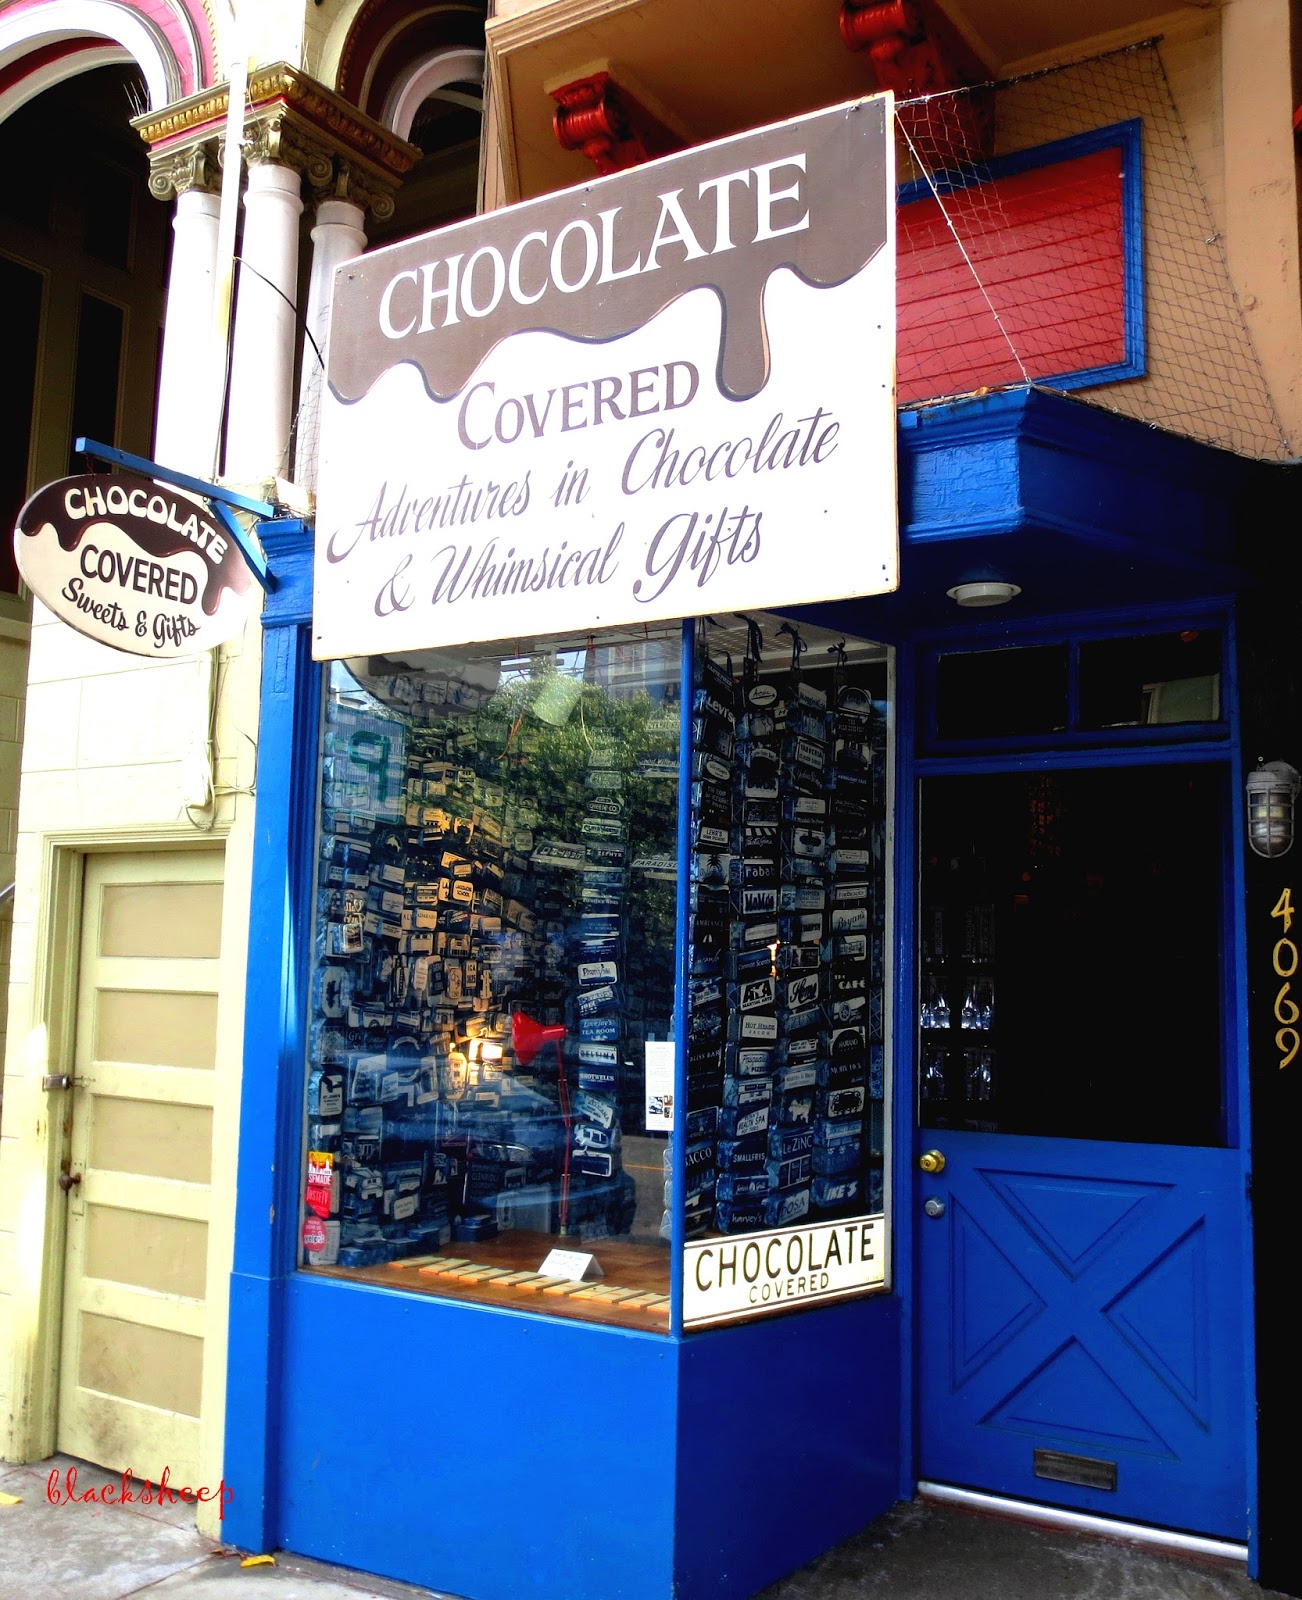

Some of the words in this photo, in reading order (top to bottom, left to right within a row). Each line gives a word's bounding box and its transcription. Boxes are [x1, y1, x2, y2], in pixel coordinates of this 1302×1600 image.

[378, 153, 810, 340] CHOCOLATE
[457, 360, 700, 450] COVERED
[326, 467, 530, 564] Adventures
[549, 460, 591, 505] in
[621, 406, 840, 496] Chocolate
[64, 485, 228, 564] CHOCOLATE
[80, 544, 198, 605] COVERED
[374, 554, 415, 618] &
[431, 521, 625, 605] Whimsical
[632, 506, 764, 603] Gifts
[62, 577, 129, 631] Sweets
[134, 610, 147, 637] &
[152, 612, 200, 648] Gifts
[1270, 887, 1300, 1070] 4069
[308, 1174, 331, 1185] SFMADE
[781, 1198, 805, 1216] DOSA
[731, 1212, 762, 1225] harvey's
[695, 1223, 875, 1292] CHOCOLATE
[749, 1272, 829, 1303] COVERED
